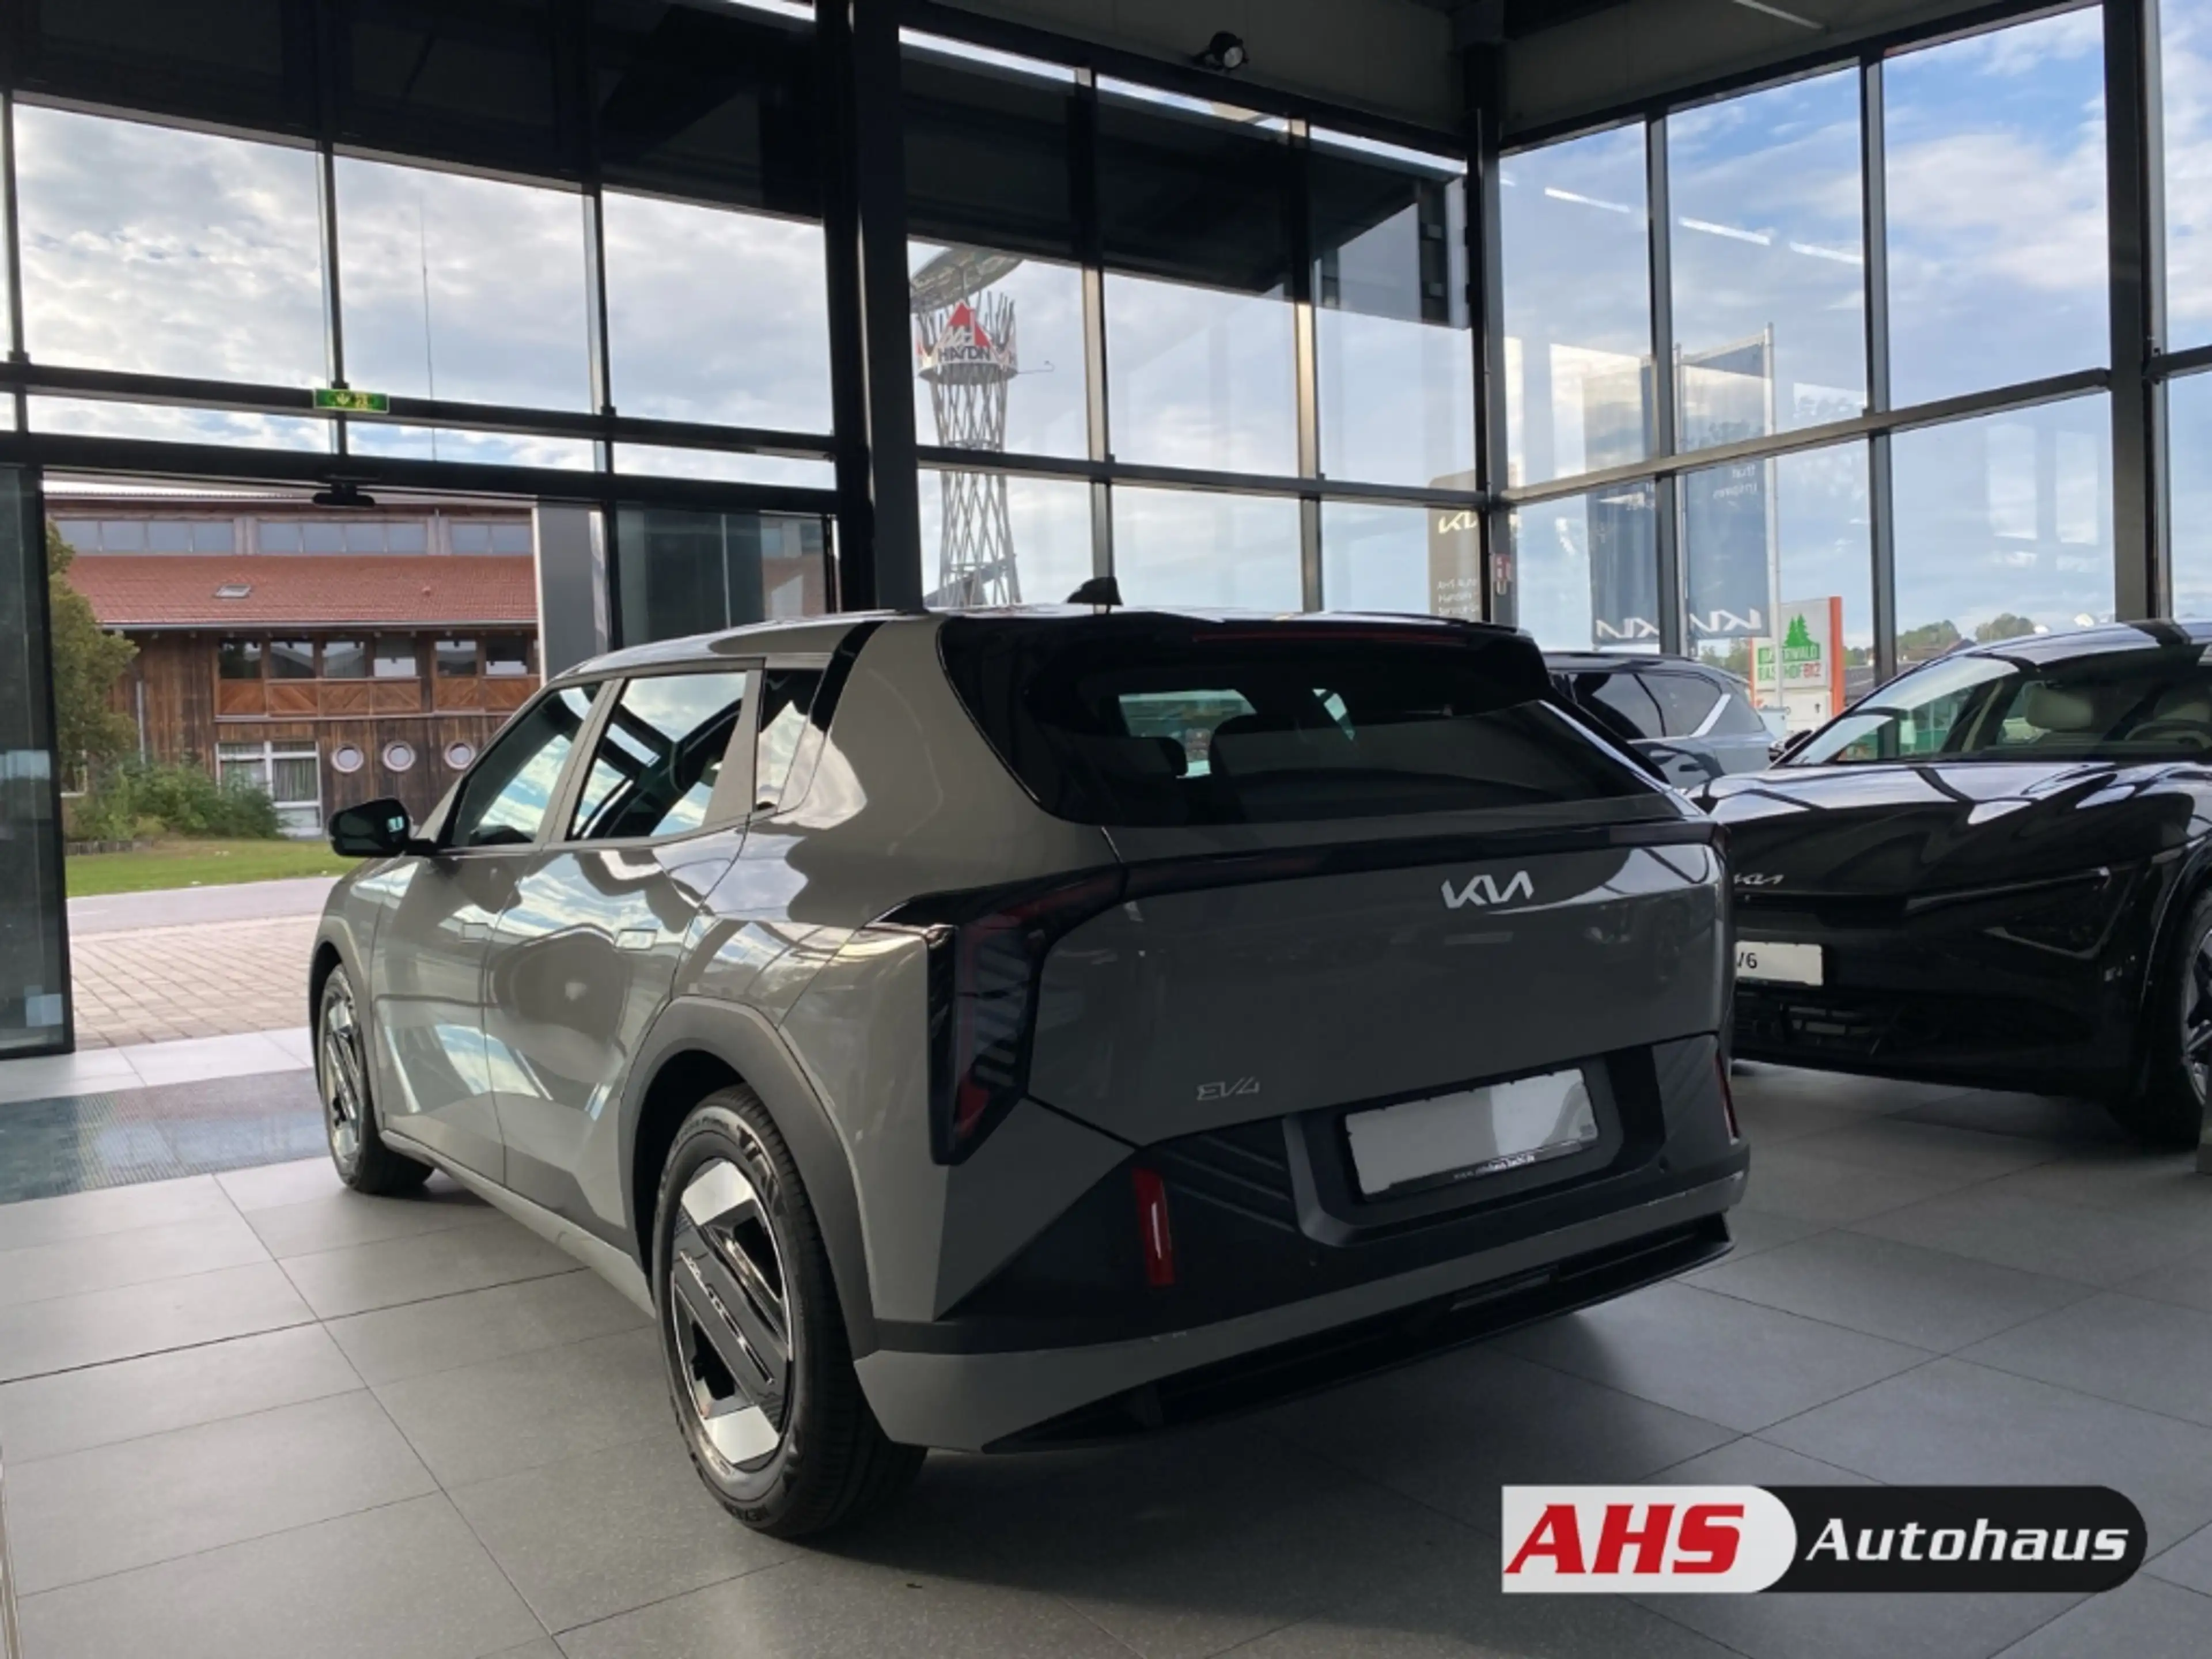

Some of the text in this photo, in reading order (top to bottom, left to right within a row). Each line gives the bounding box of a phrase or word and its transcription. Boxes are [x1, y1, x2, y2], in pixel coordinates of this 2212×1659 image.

[938, 346, 991, 362] HAYDN
[1438, 509, 1478, 534] KI
[1759, 646, 1818, 663] BARWALD
[1758, 664, 1802, 682] RASHOF
[1440, 870, 1534, 908] KIA
[1196, 1075, 1260, 1101] EV4
